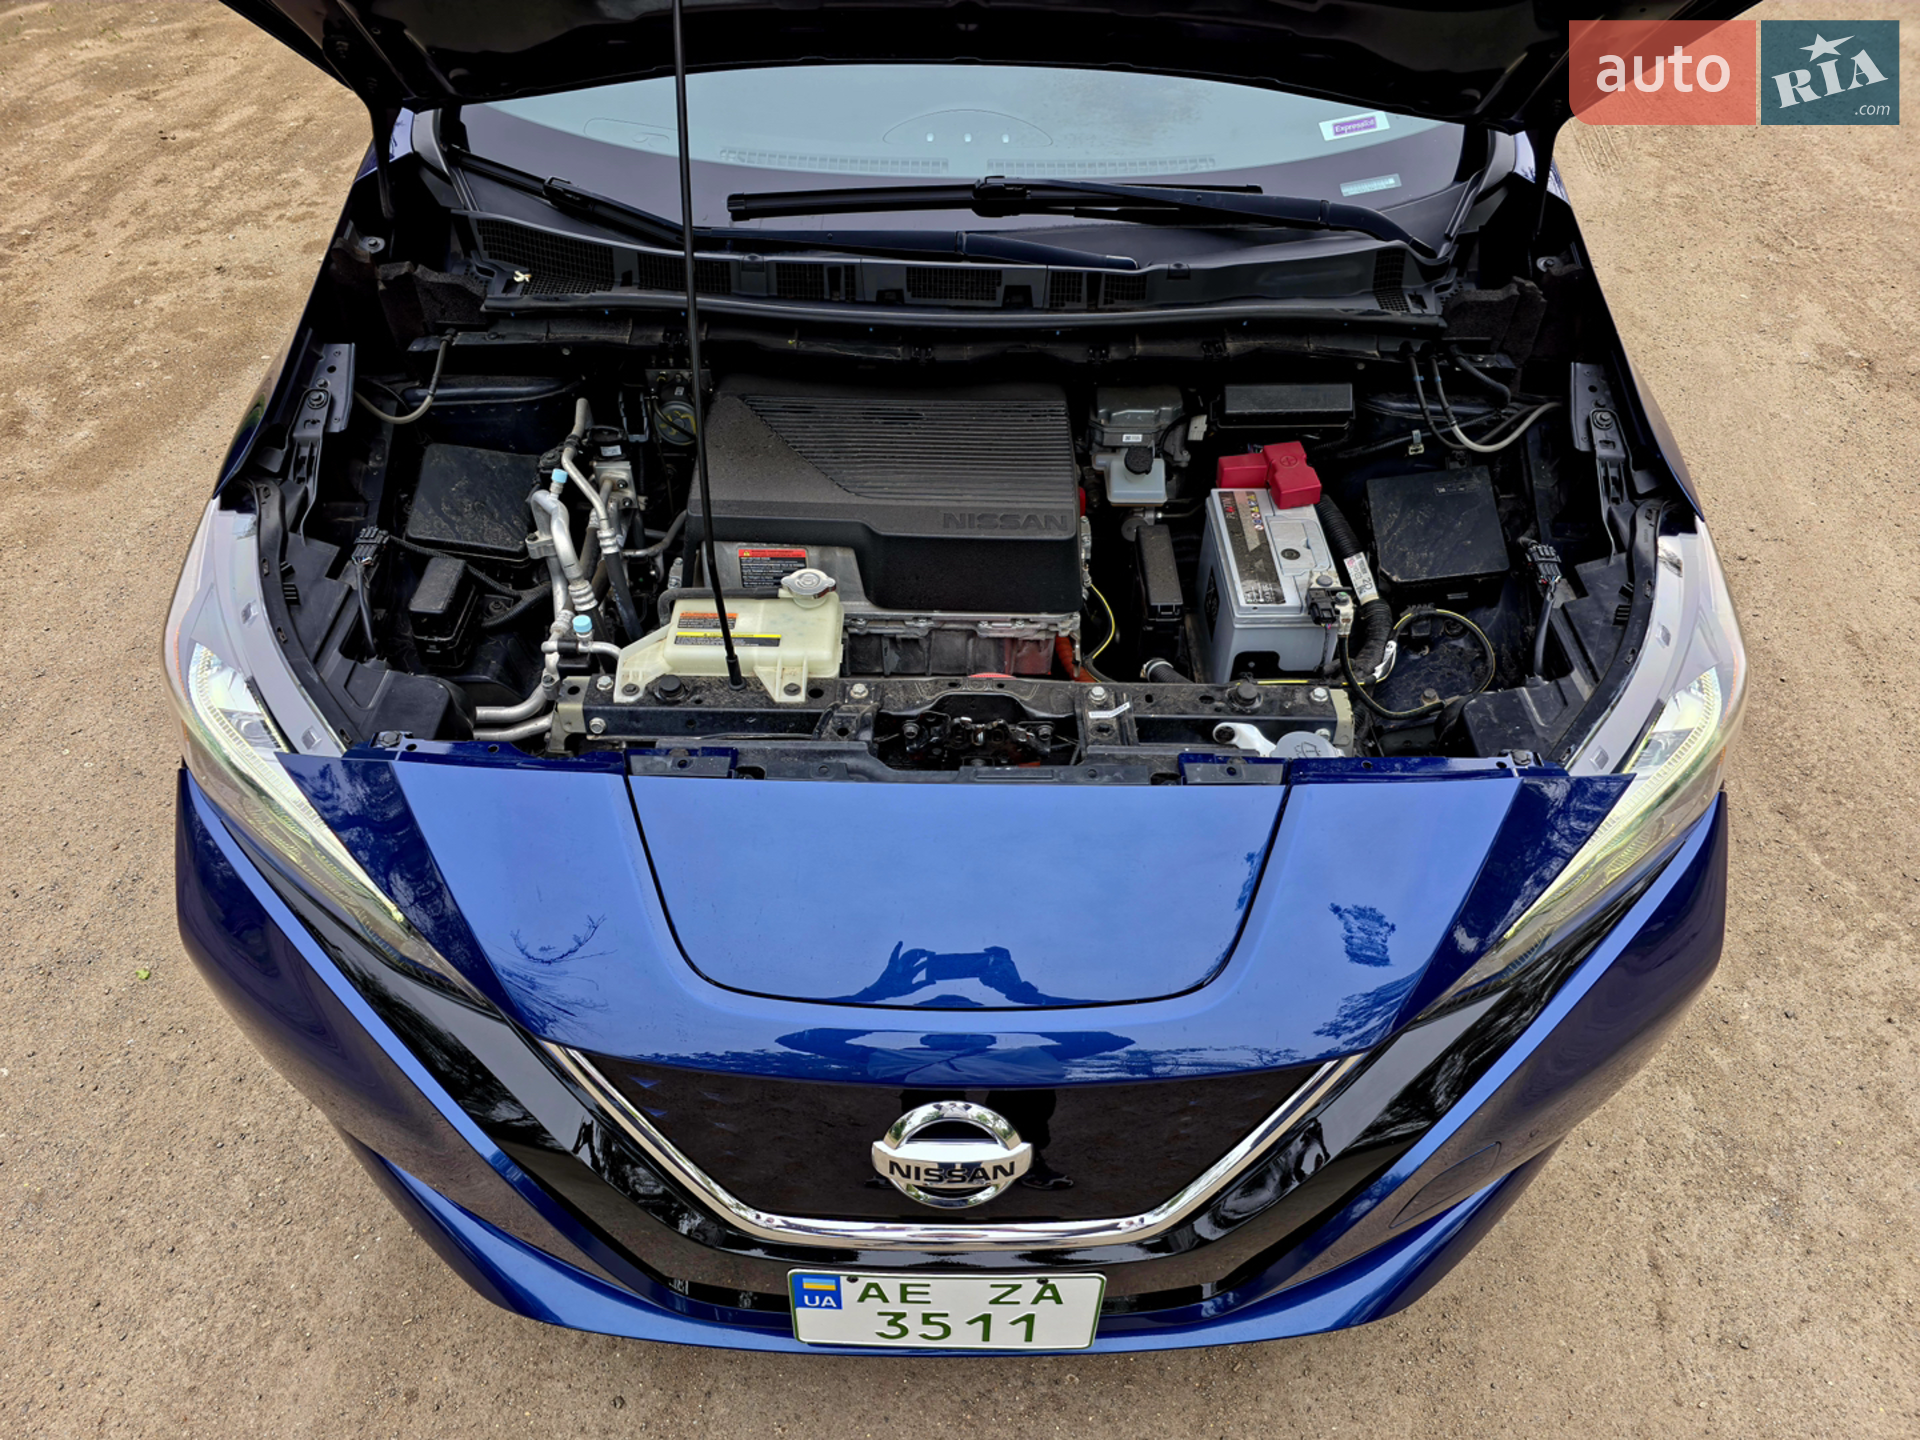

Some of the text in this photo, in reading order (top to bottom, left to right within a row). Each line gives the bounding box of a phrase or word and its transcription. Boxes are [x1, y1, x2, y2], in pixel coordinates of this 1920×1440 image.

[943, 512, 1069, 531] NISSAN
[888, 1160, 1015, 1184] NISSAN
[803, 1282, 1064, 1307] UA AE ZA
[874, 1311, 1036, 1342] 3511
